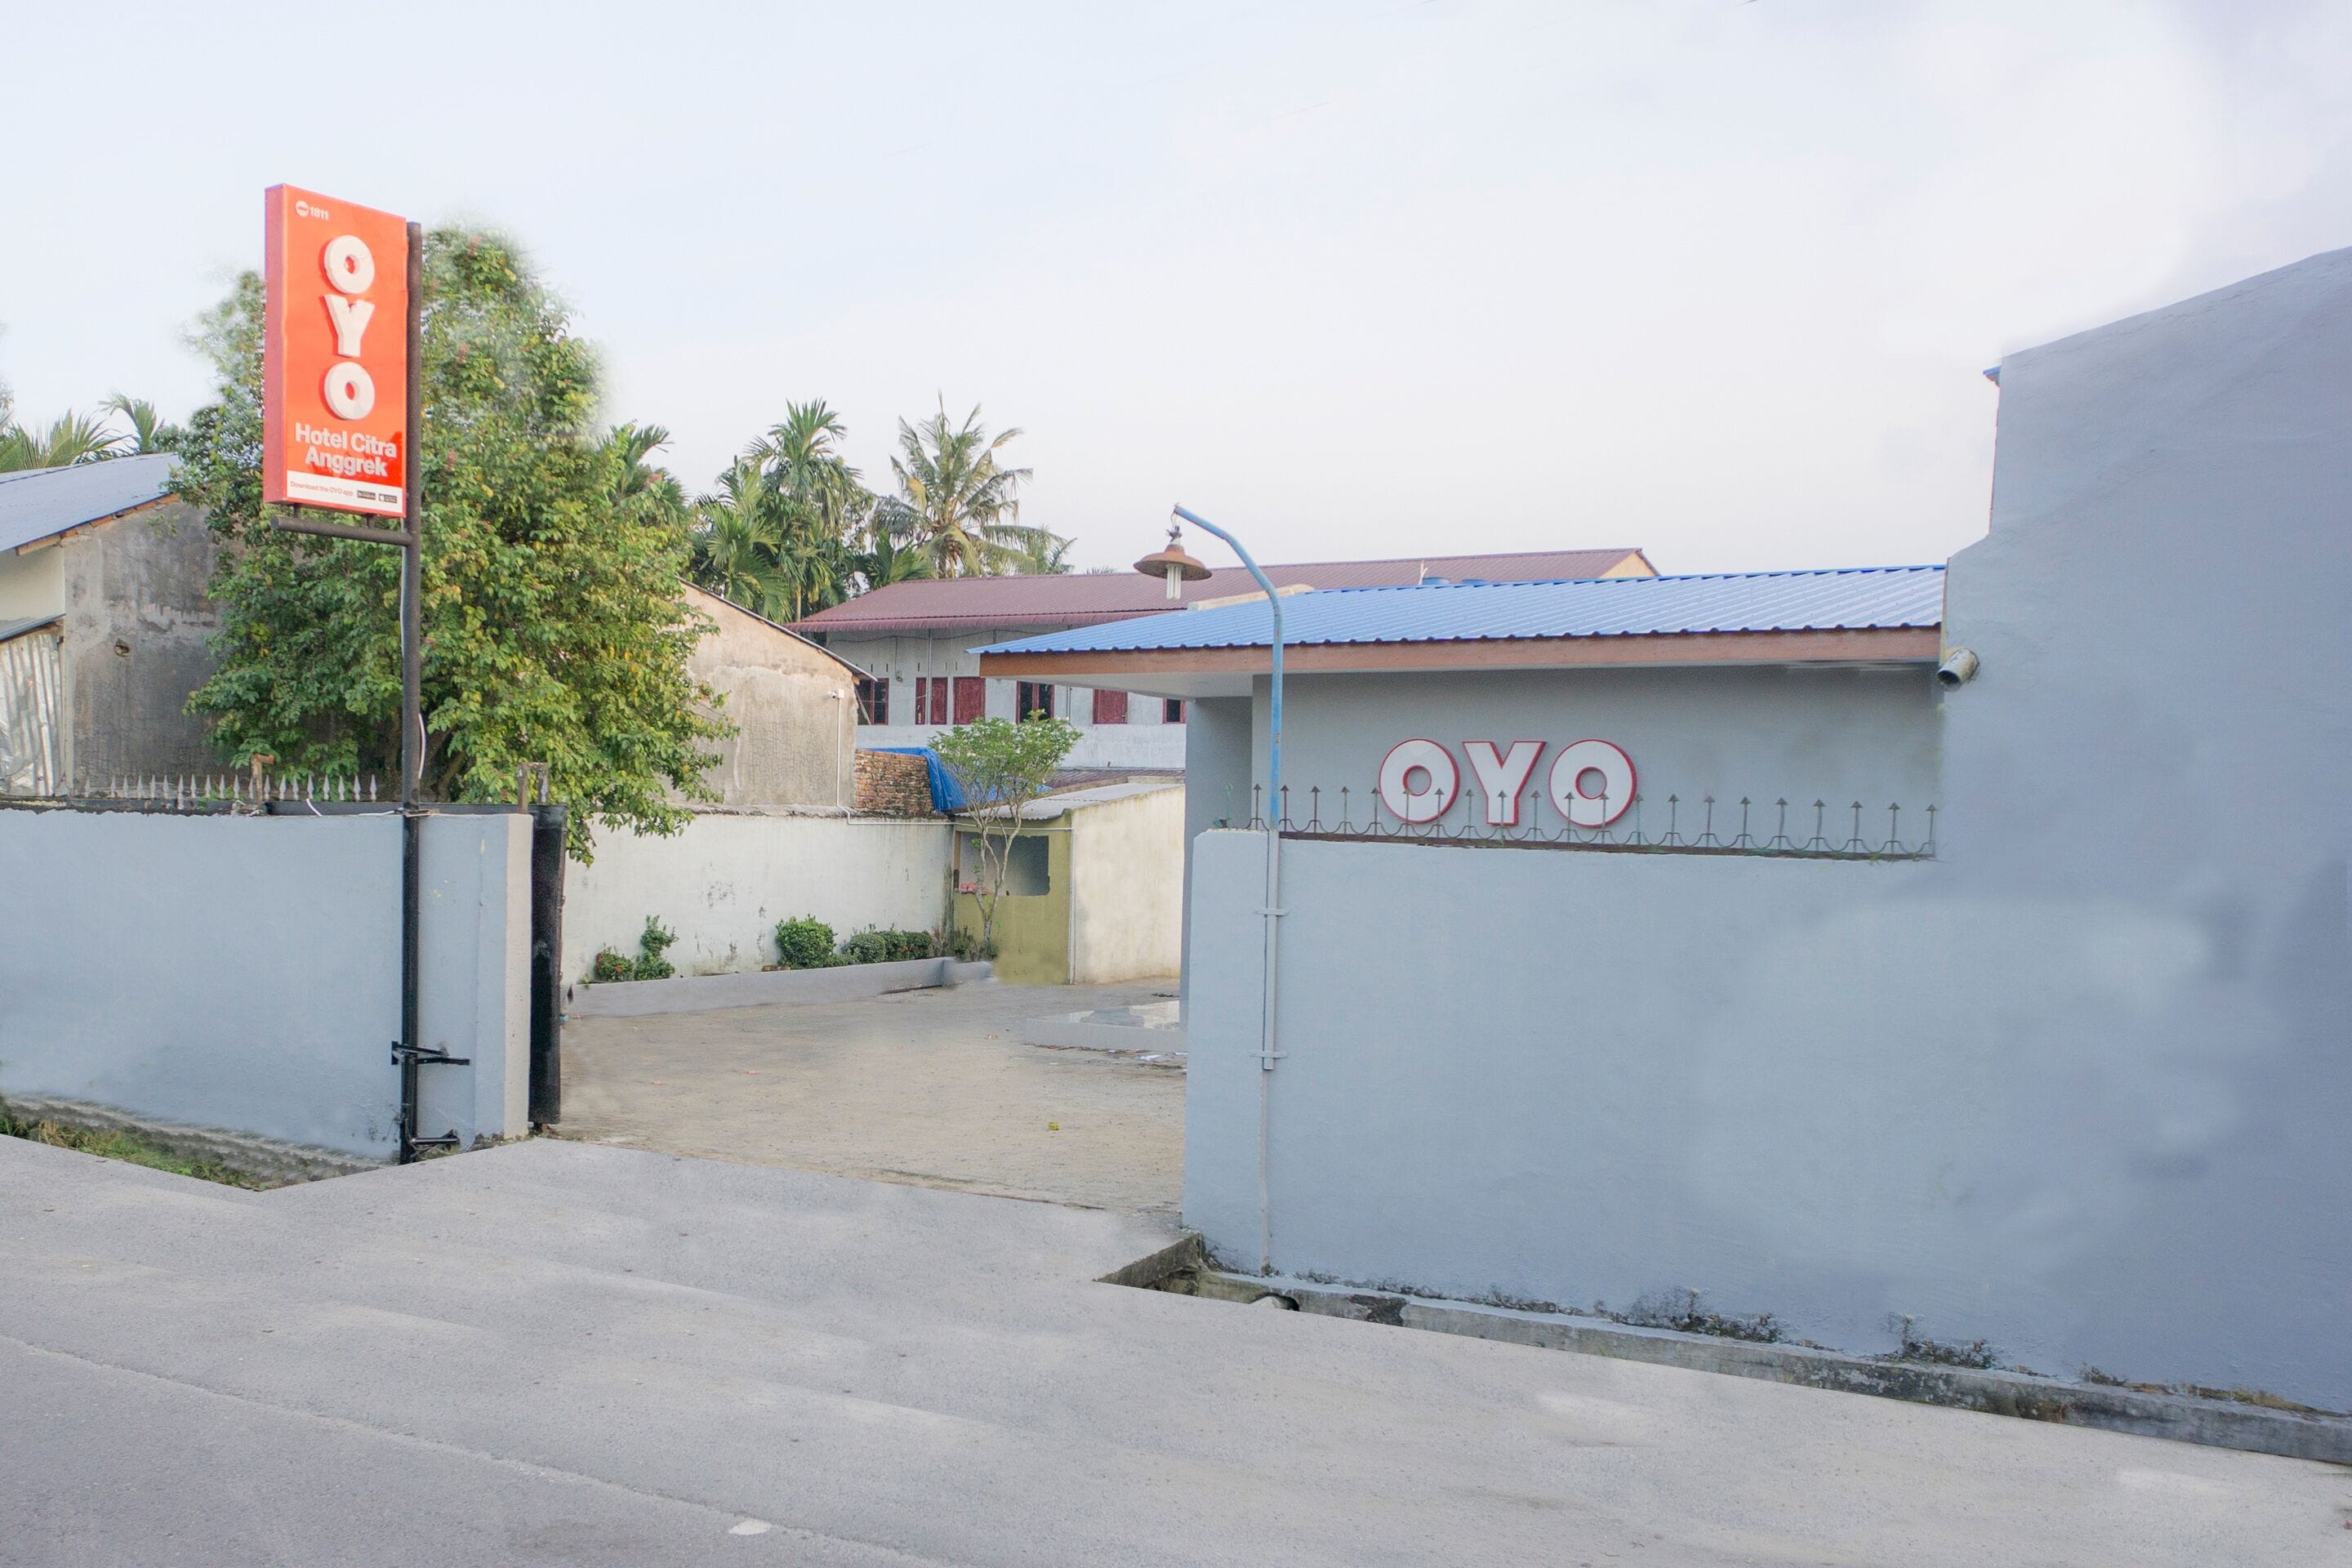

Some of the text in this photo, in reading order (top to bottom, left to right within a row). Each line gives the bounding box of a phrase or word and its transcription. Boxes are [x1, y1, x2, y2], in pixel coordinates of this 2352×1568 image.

[323, 234, 376, 421] OYO
[295, 421, 397, 458] Hotel Citra
[305, 445, 389, 477] Anggrek
[290, 480, 318, 491] Download
[343, 489, 354, 497] app
[1379, 738, 1637, 828] OYO
